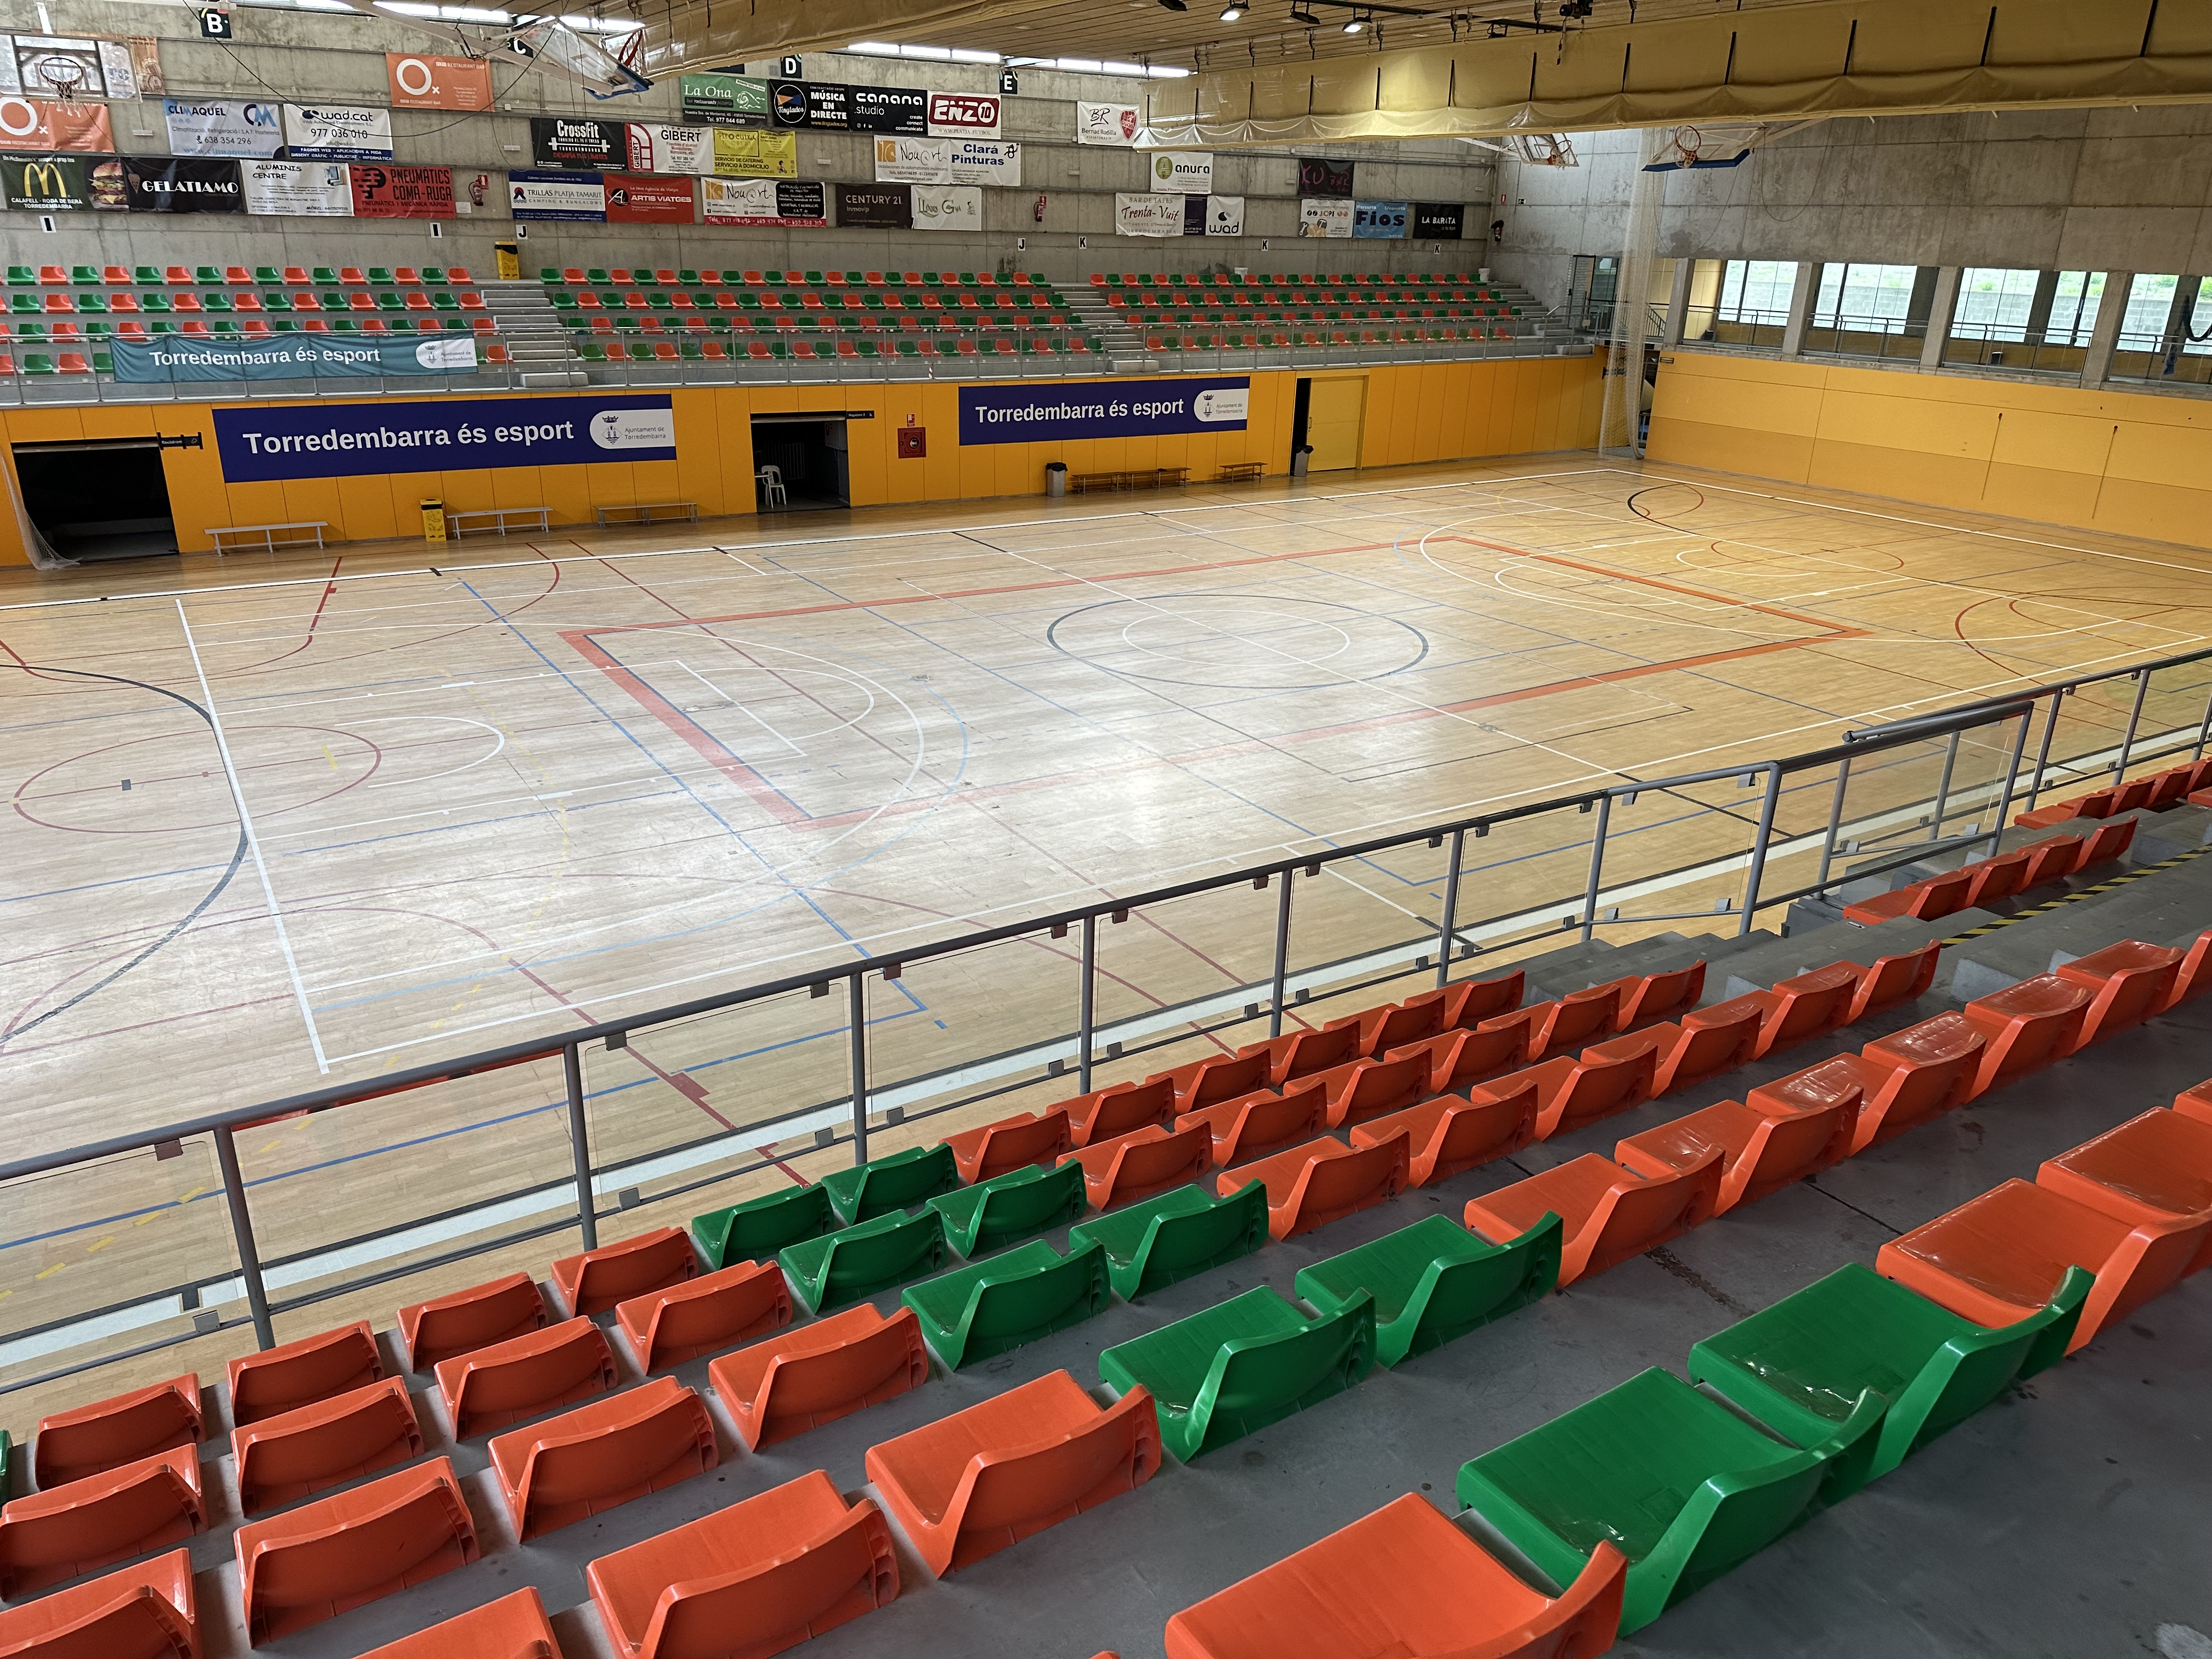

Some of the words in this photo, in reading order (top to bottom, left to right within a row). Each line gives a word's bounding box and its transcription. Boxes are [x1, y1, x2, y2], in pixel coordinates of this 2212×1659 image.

[206, 13, 223, 33] B
[785, 57, 797, 74] D
[1004, 75, 1013, 91] E
[685, 84, 702, 96] La
[706, 86, 732, 98] Ona
[811, 90, 845, 101] MÚSICA
[856, 93, 923, 105] canana
[168, 105, 226, 116] CLIMAQUEL
[243, 104, 277, 127] CM
[321, 110, 374, 122] wad.cat
[777, 106, 804, 115] Tinglados
[810, 110, 847, 120] DIRECTE
[1090, 108, 1110, 125] BR
[311, 128, 328, 137] 977
[331, 129, 348, 138] 036
[351, 130, 368, 138] 010
[557, 120, 599, 138] CrossFit
[661, 129, 702, 142] GIBERT
[963, 144, 998, 154] Clará
[951, 154, 1005, 166] Pinturas
[390, 167, 450, 184] PNEUMÀTICS
[1175, 164, 1210, 174] anura
[142, 180, 239, 194] GELATIAMO
[393, 185, 453, 201] COMA-RUGA
[845, 195, 891, 205] CENTURY
[1356, 211, 1405, 226] Fios
[518, 225, 527, 238] J
[1209, 221, 1239, 234] wad
[1018, 239, 1025, 250] J
[1080, 237, 1086, 248] K
[1262, 240, 1268, 250] K
[1435, 244, 1440, 253] K
[149, 349, 291, 366] Torredembarra
[295, 346, 318, 362] és
[322, 348, 381, 365] esport
[975, 402, 1105, 424] Torredembarra
[1109, 399, 1128, 417] és
[1132, 398, 1184, 419] esport
[242, 426, 451, 454] Torredembarra
[458, 423, 487, 445] és
[494, 420, 574, 446] esport
